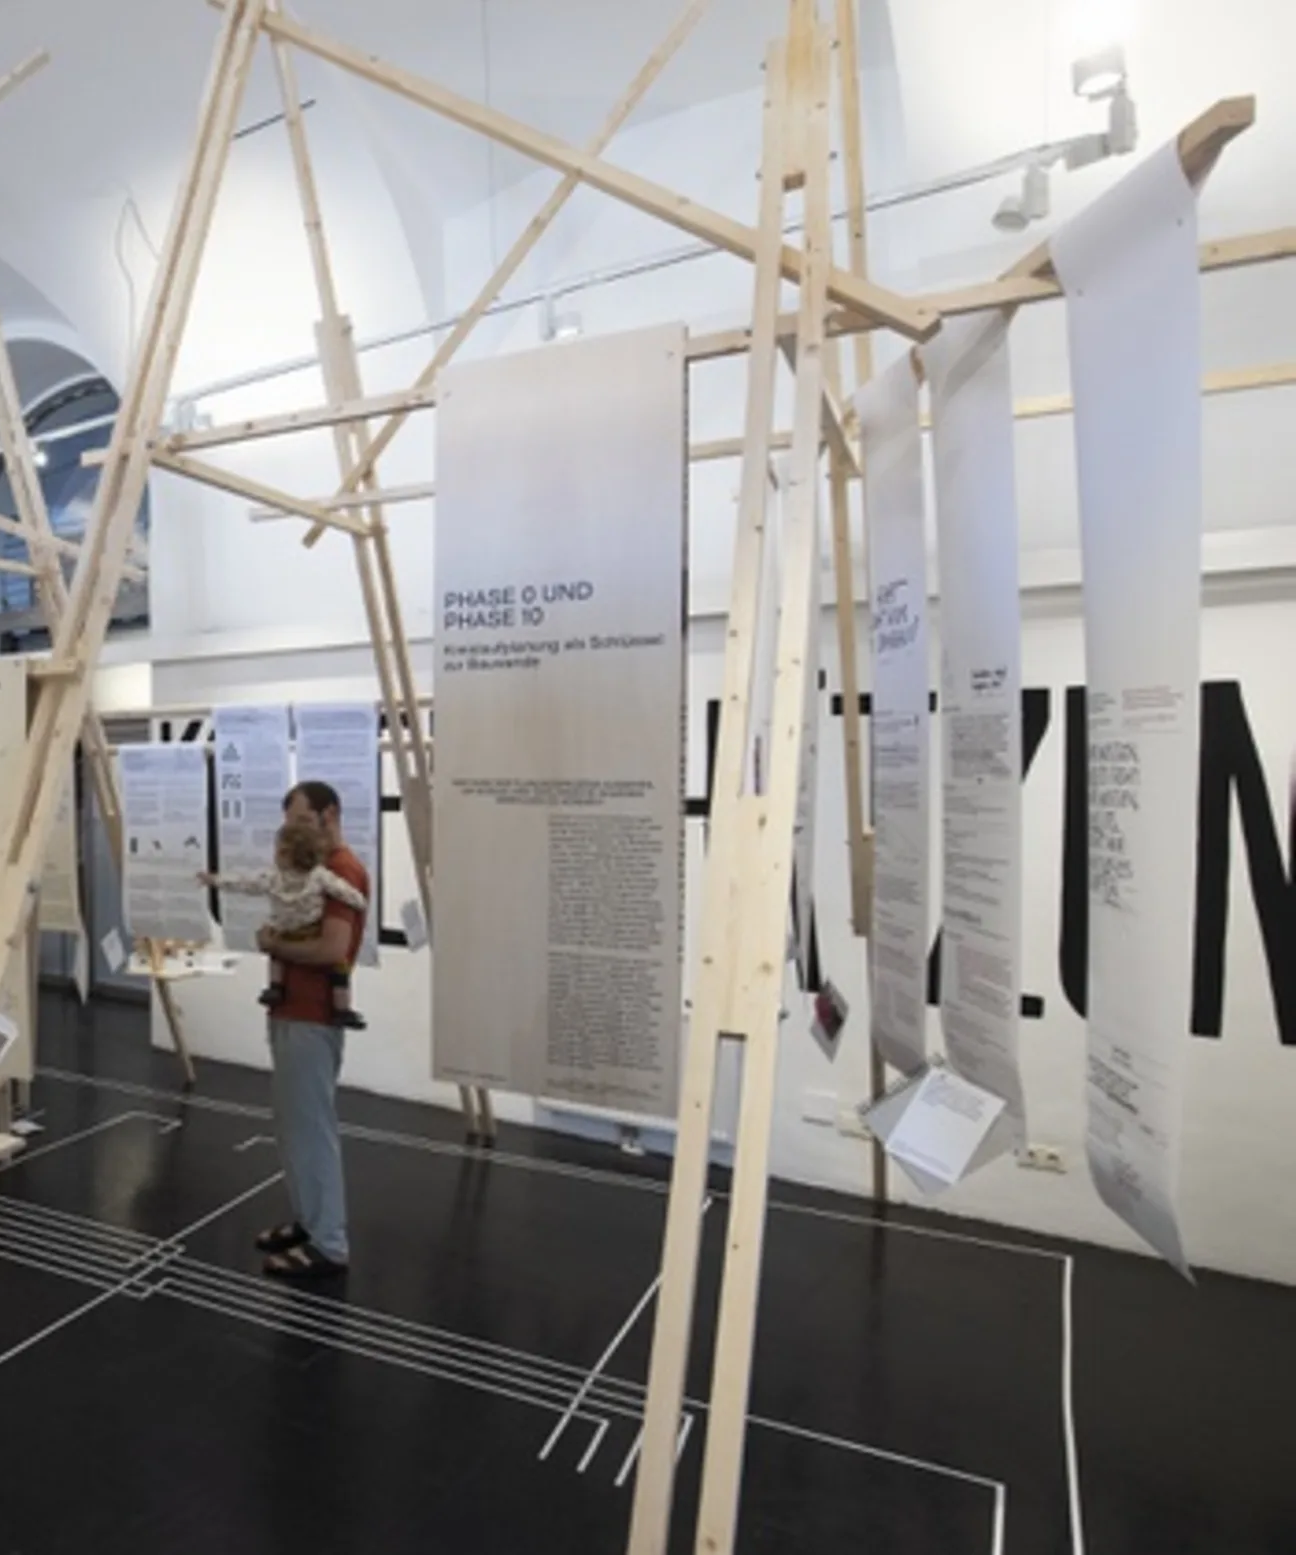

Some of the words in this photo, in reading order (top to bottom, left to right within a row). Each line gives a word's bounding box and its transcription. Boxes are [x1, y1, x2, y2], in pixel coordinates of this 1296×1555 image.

[443, 586, 517, 609] PHASE
[542, 580, 594, 603] UND
[443, 607, 517, 630] PHASE
[521, 606, 545, 627] 10
[564, 635, 586, 650] als
[589, 631, 665, 650] Schlüssel
[466, 656, 541, 671] Bauwende
